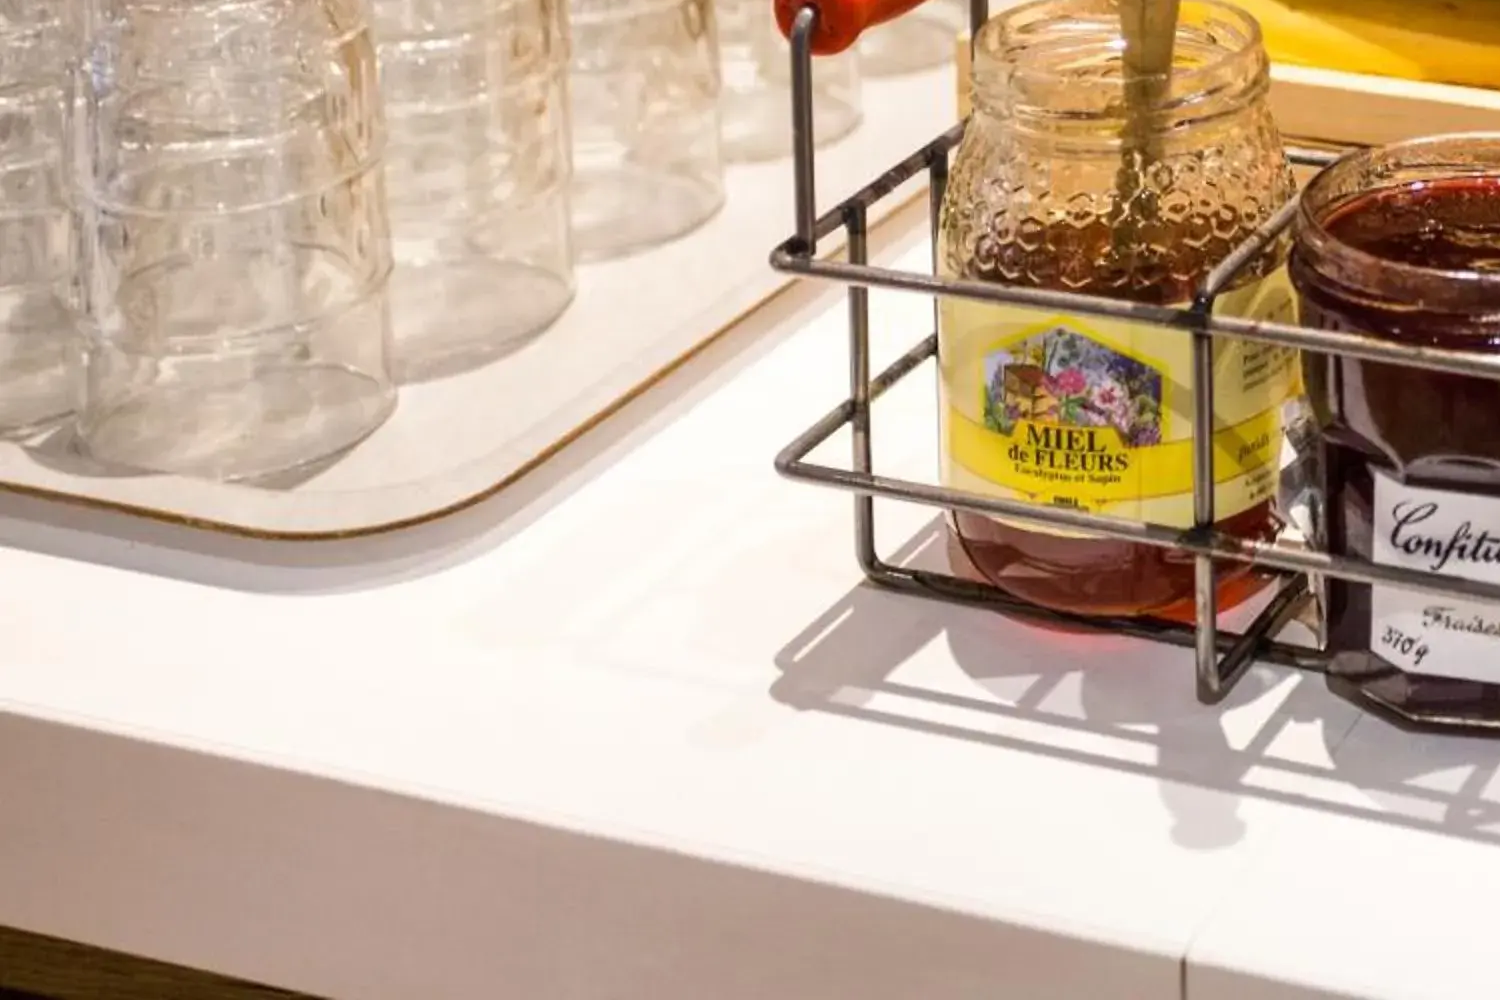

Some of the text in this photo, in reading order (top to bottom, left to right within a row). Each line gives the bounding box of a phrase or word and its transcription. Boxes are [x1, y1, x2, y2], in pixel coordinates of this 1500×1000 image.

[1027, 423, 1107, 452] MIEL
[1008, 444, 1128, 471] de FLEURS
